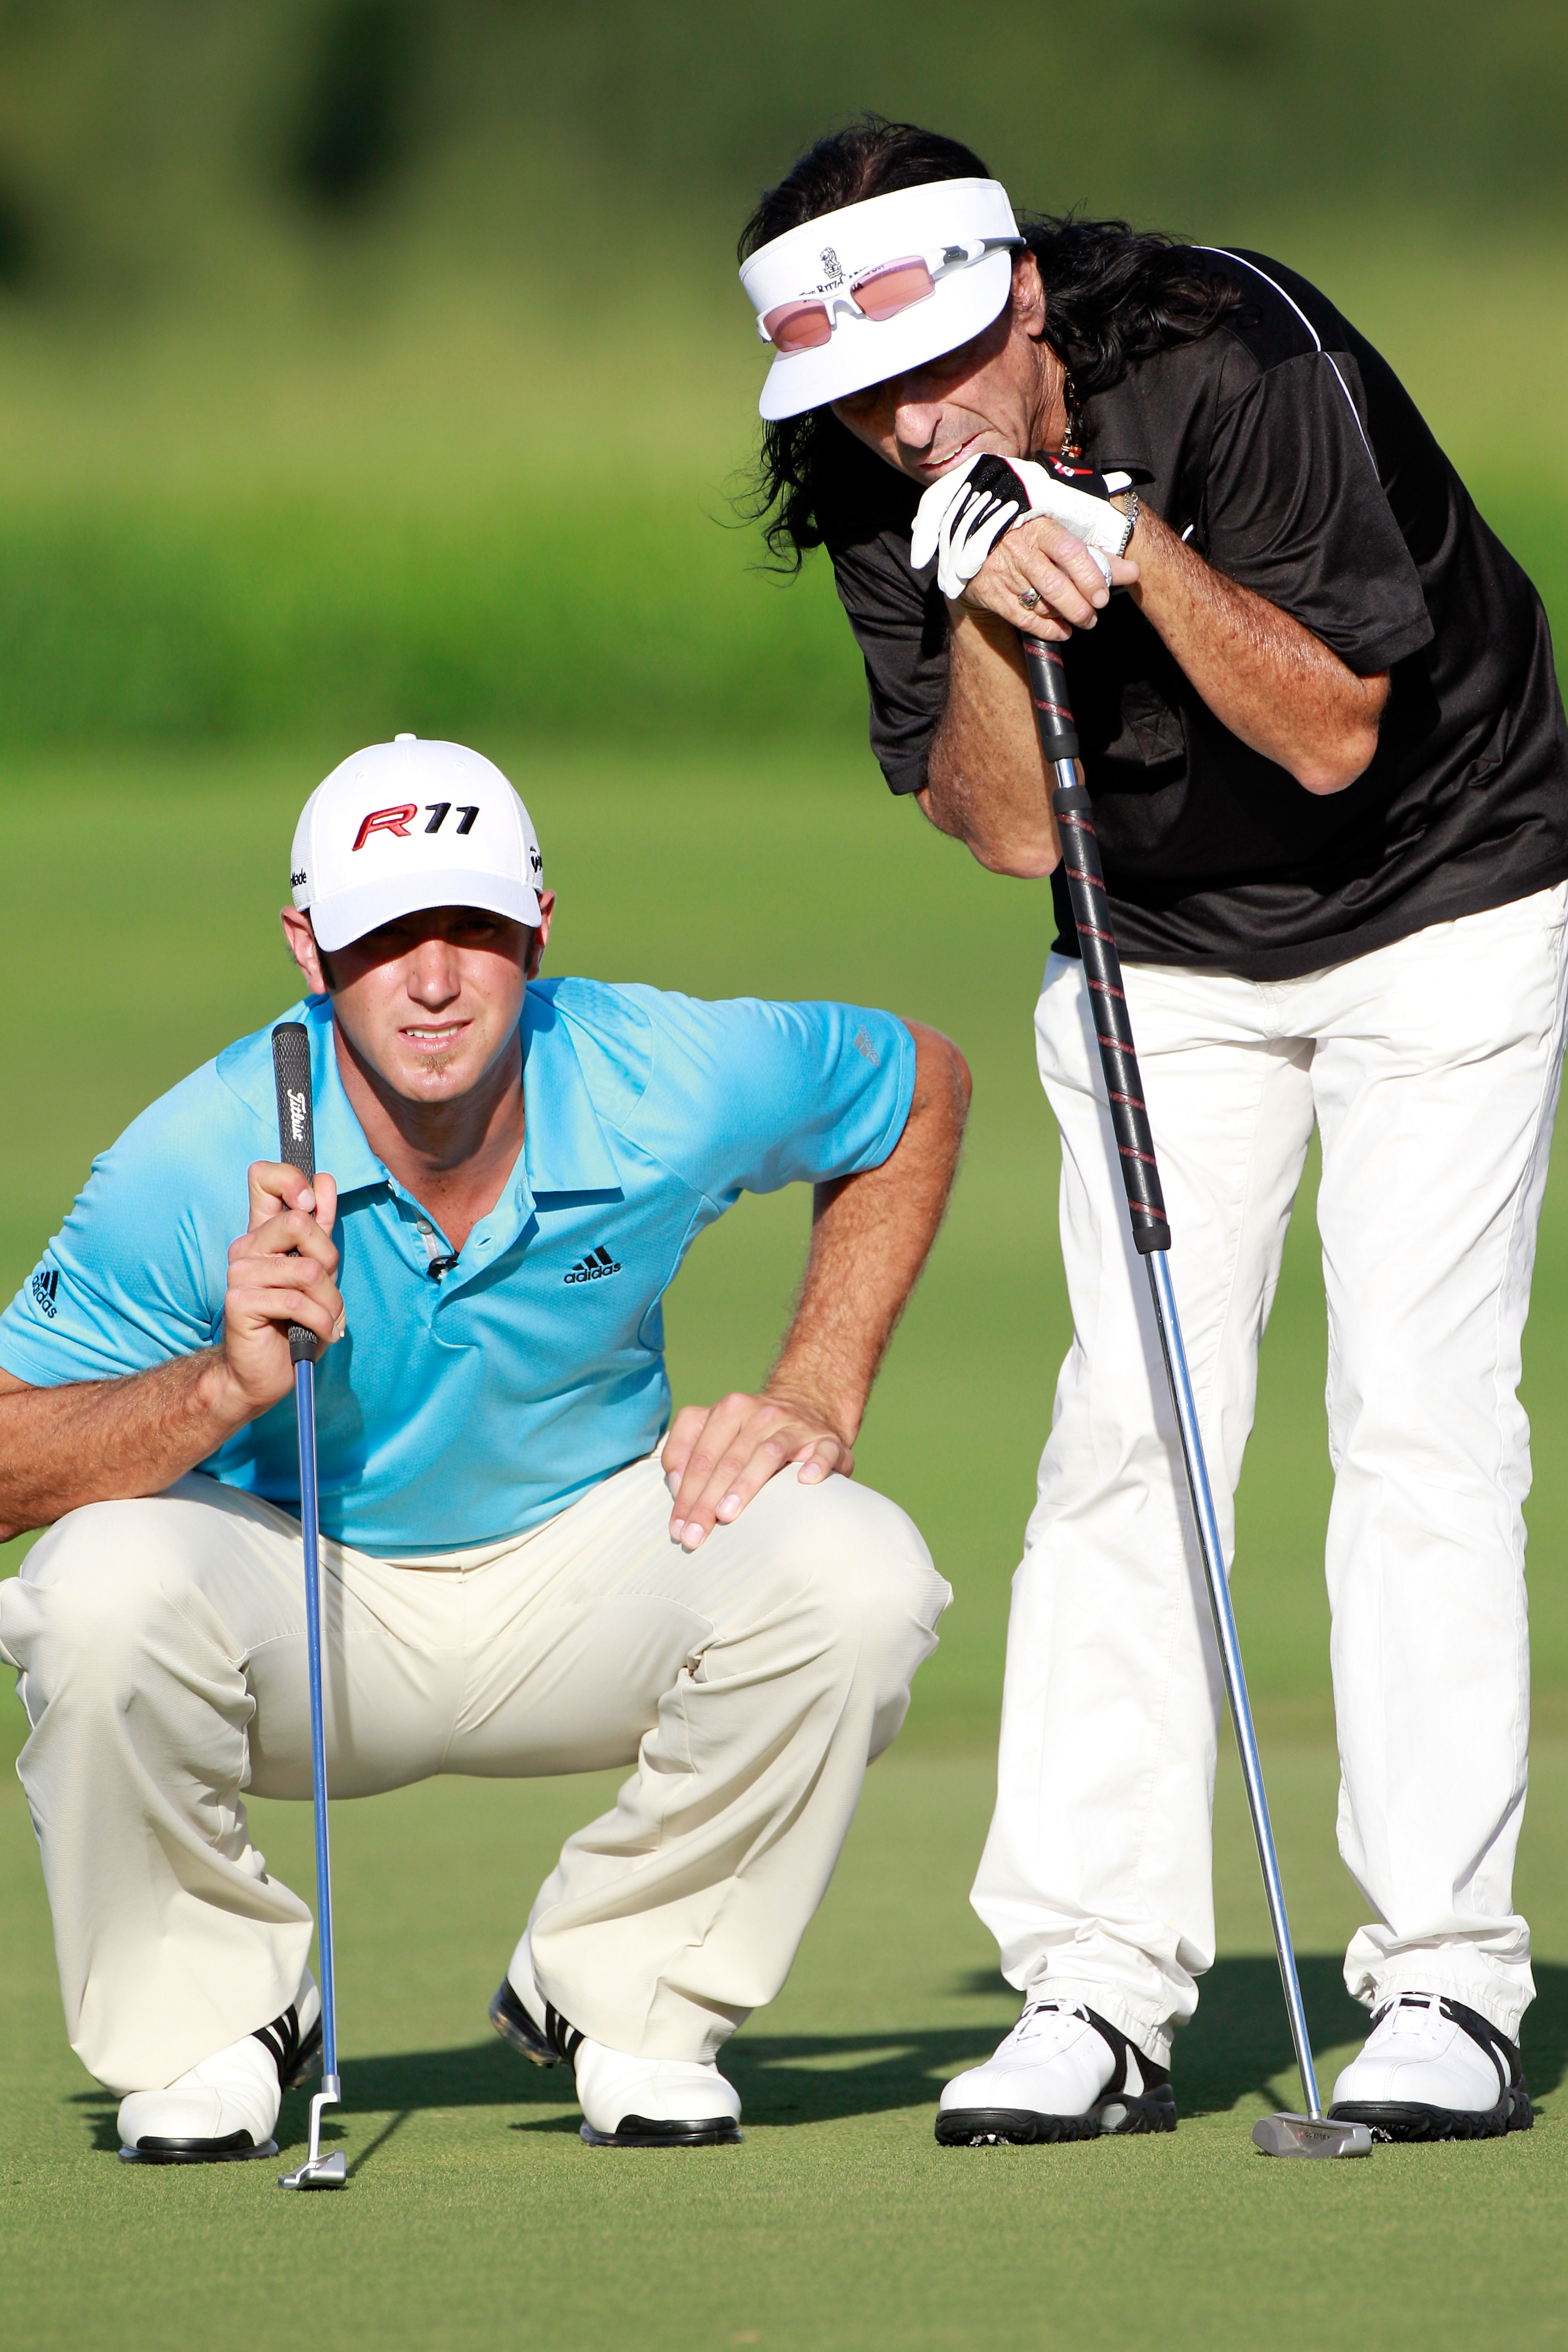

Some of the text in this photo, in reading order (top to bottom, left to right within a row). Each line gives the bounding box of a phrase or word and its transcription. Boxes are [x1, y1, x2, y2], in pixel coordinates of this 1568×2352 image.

[352, 802, 479, 852] R11
[287, 1089, 306, 1142] Titleist
[564, 1262, 621, 1284] adidas
[32, 1275, 57, 1318] adidas
[1305, 2132, 1330, 2140] ODYSSEY
